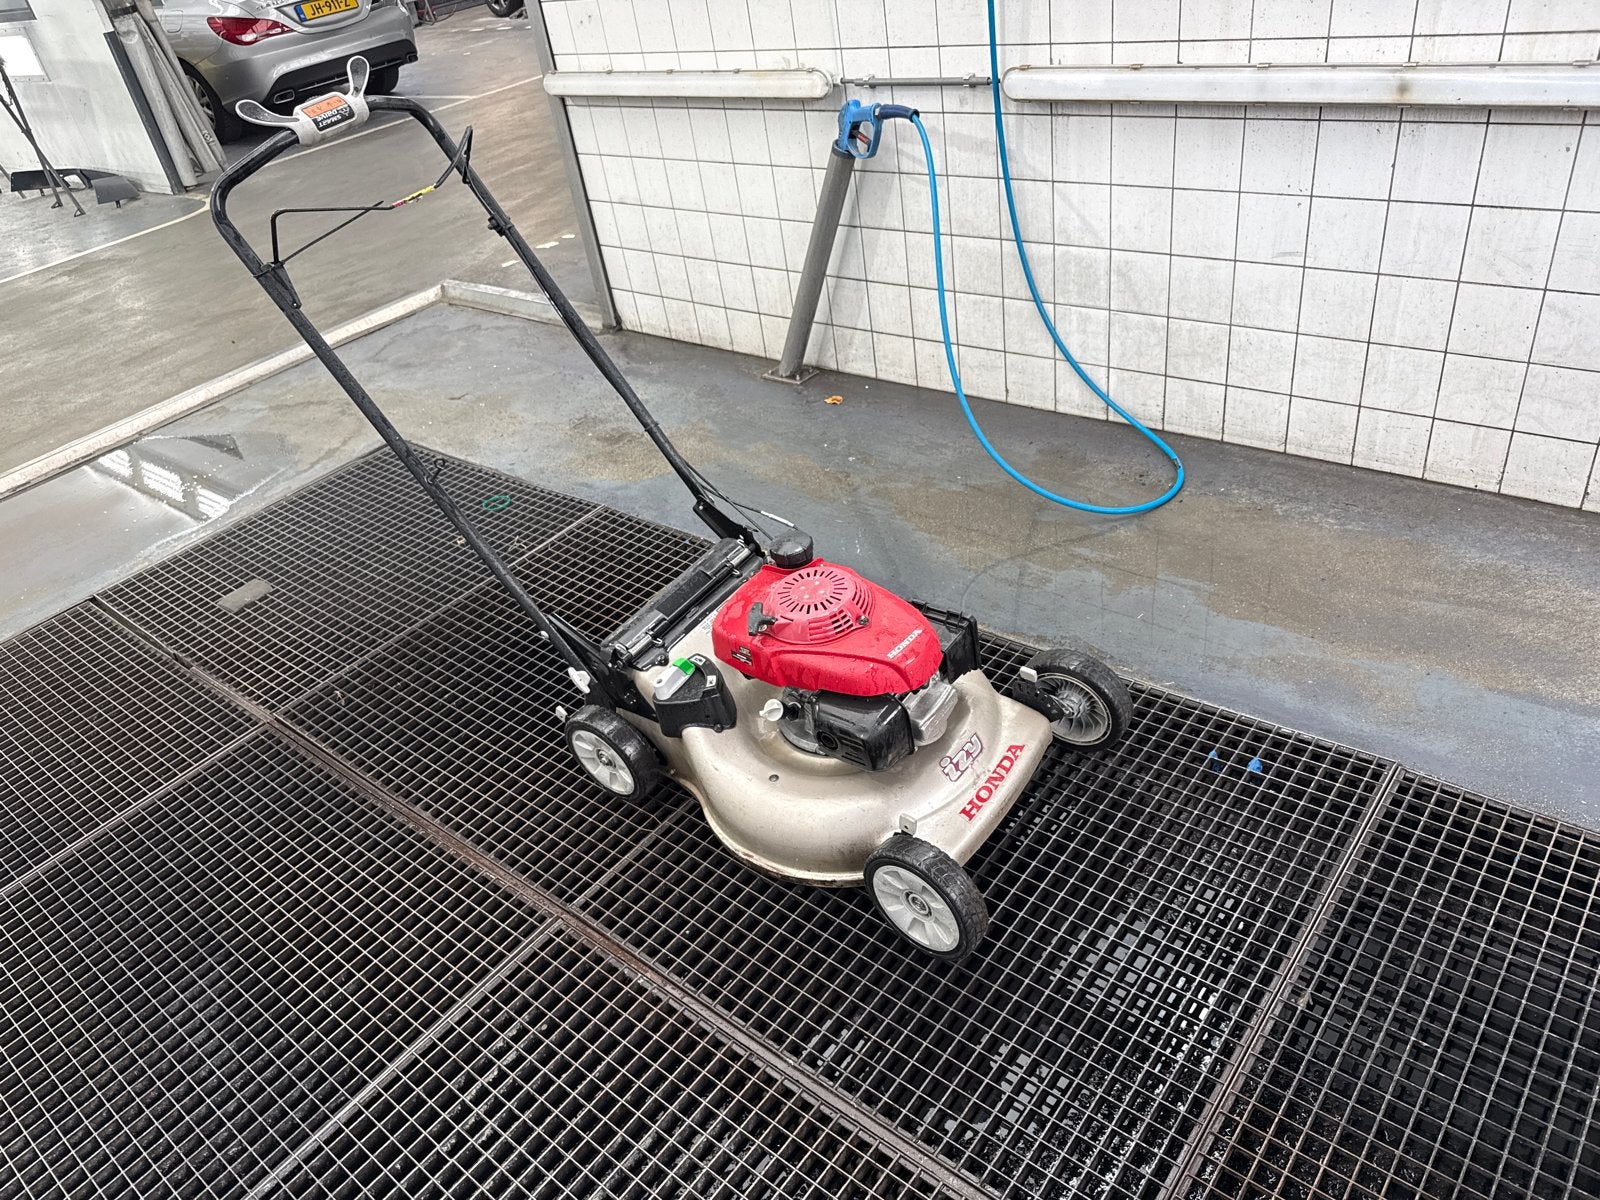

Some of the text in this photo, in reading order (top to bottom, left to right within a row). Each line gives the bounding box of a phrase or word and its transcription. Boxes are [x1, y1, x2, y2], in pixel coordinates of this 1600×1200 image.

[886, 629, 923, 659] HONDA
[939, 732, 983, 782] izy
[959, 744, 1025, 821] HONDA
